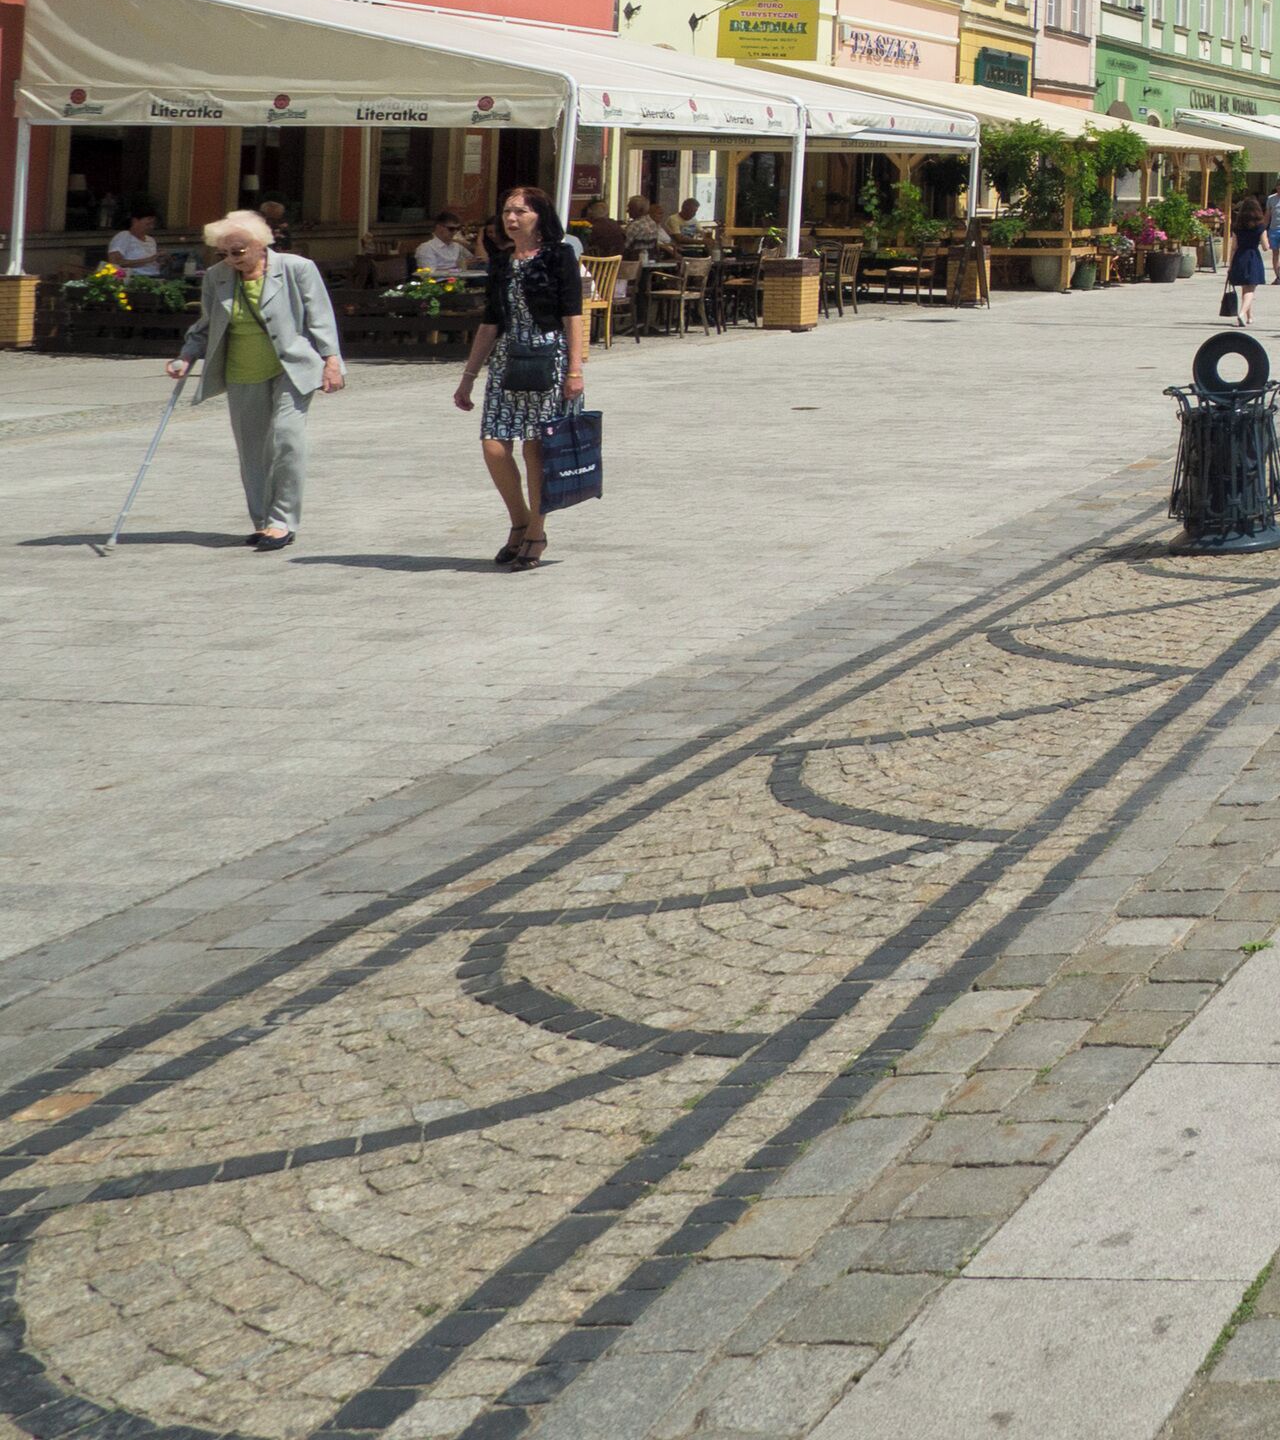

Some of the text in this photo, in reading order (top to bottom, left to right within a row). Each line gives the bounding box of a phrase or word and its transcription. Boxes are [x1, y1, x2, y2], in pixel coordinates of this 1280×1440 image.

[850, 30, 921, 63] TASZKA
[150, 104, 223, 119] Literatka
[356, 108, 429, 122] Literatka
[641, 106, 676, 120] Literatka
